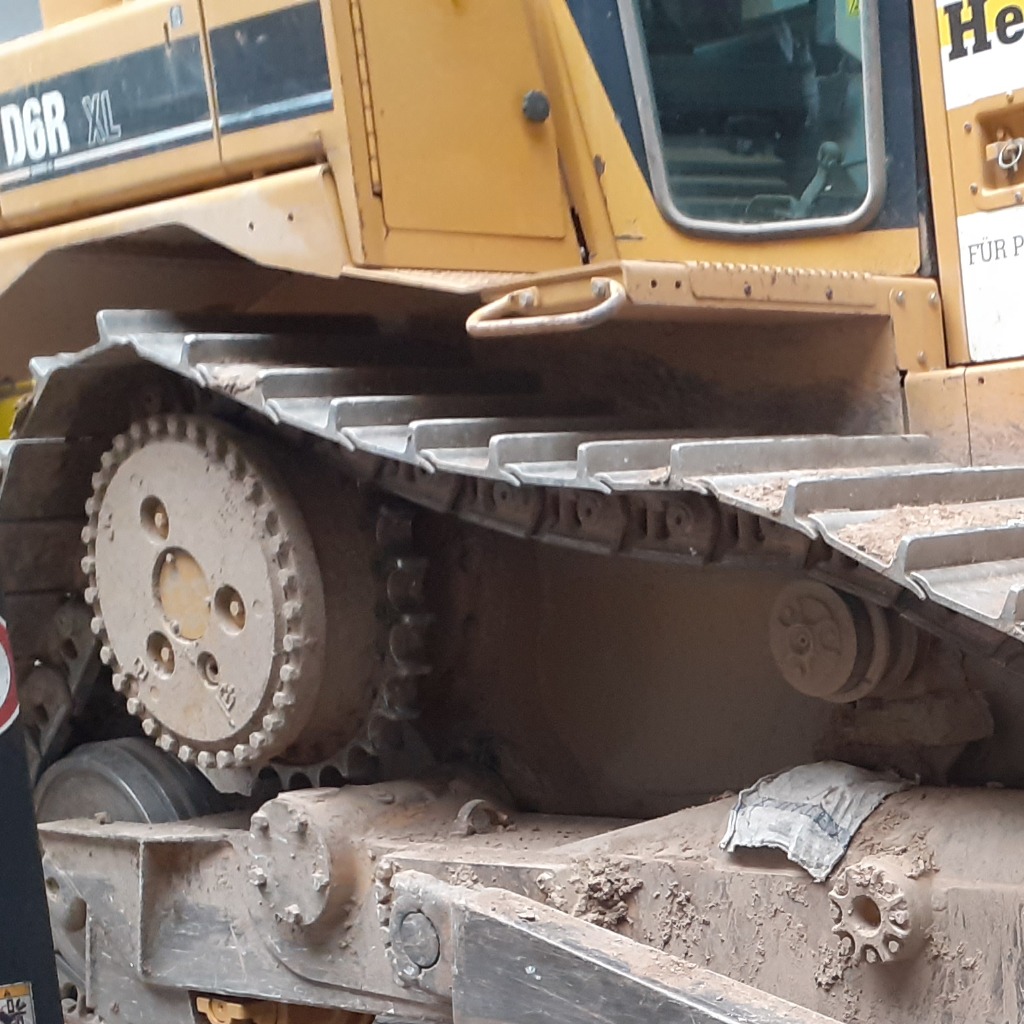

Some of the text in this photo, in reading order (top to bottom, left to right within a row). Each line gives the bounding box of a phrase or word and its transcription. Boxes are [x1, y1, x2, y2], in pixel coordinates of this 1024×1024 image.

[1, 89, 122, 167] D6R XL
[968, 237, 1008, 265] FÜR
